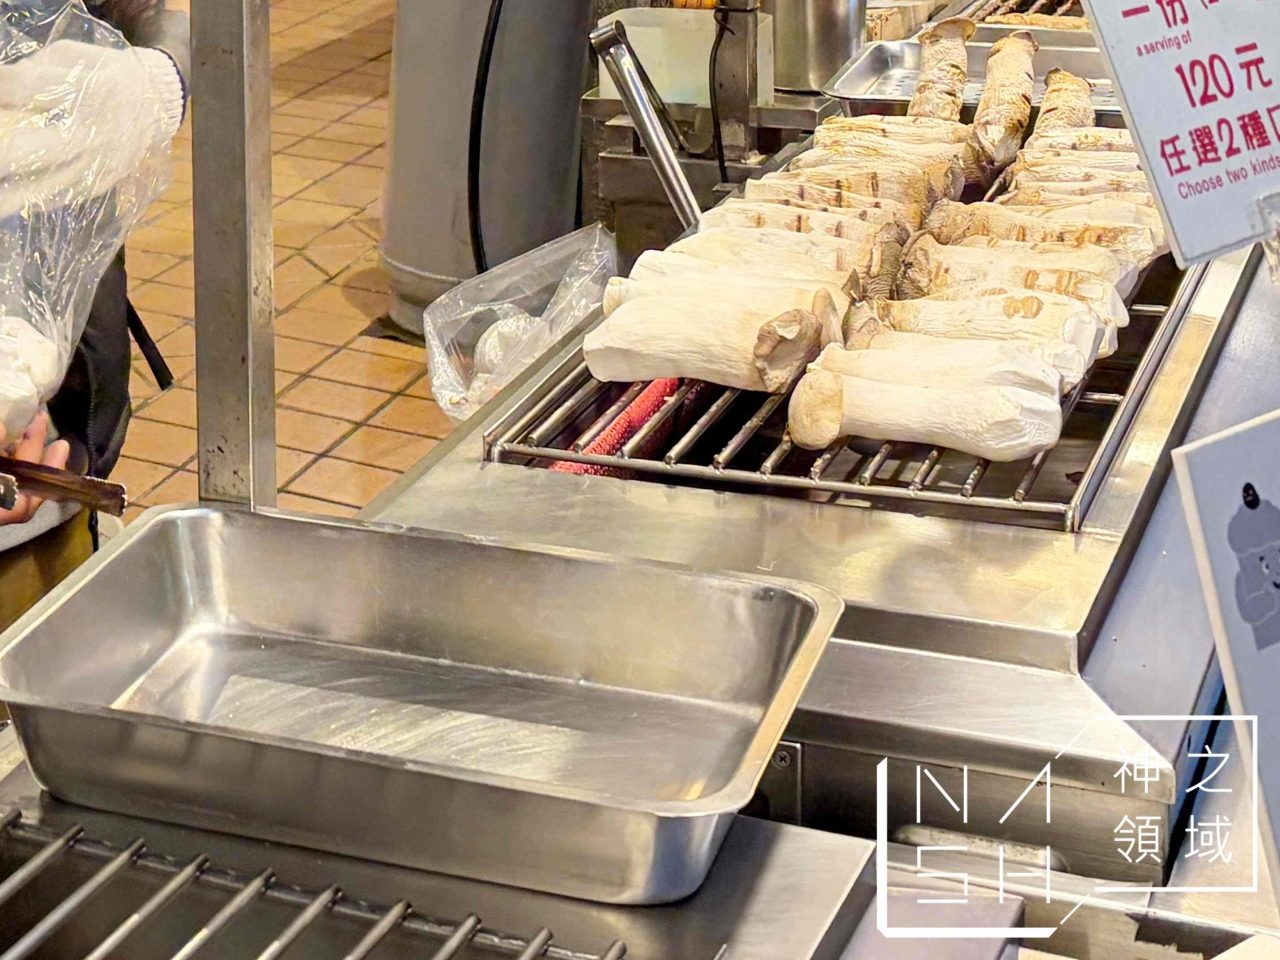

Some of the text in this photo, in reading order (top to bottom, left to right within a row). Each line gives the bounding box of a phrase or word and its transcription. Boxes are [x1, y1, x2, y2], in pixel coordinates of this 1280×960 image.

[1143, 34, 1182, 55] serving
[1177, 175, 1224, 200] Choose
[1225, 167, 1248, 184] two
